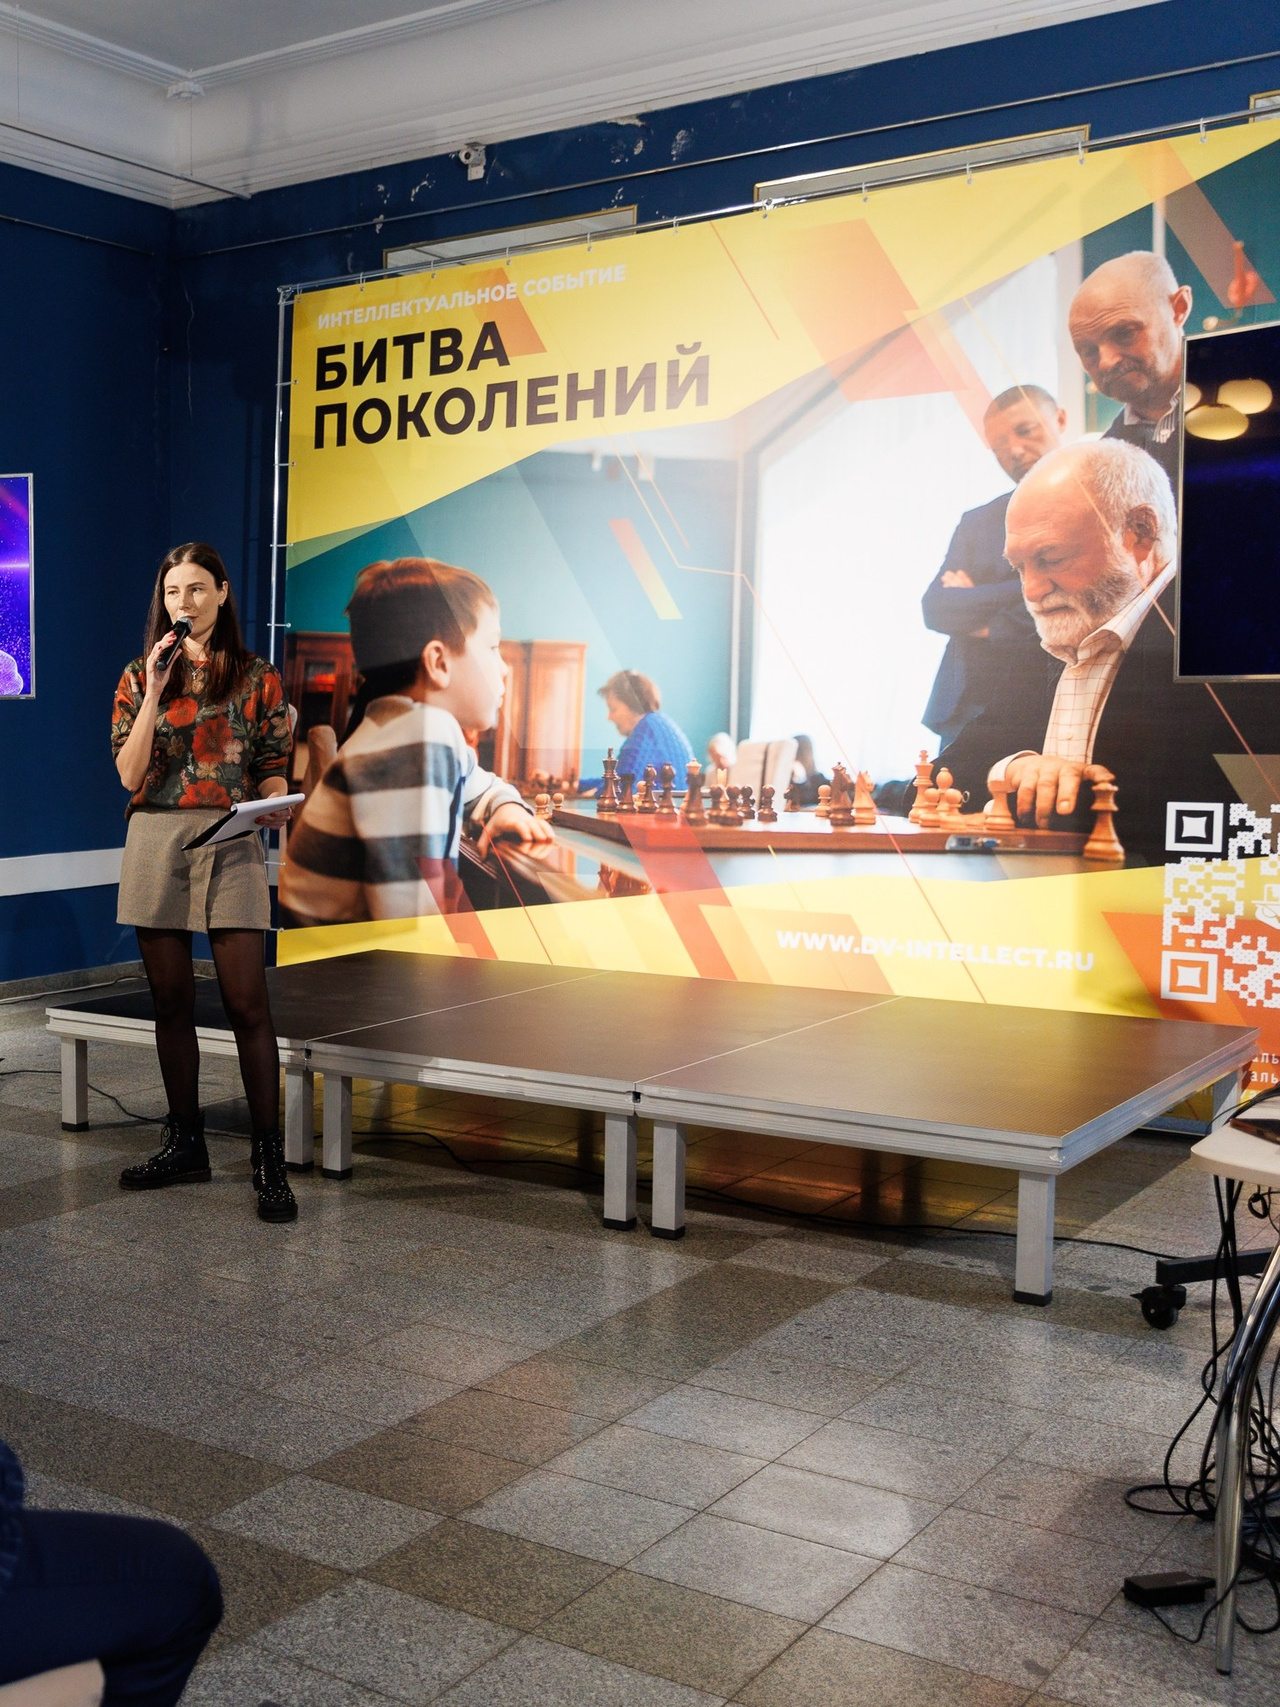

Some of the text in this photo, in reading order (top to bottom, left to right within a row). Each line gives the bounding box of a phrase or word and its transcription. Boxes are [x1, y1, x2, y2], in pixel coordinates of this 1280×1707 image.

[317, 264, 627, 330] ИНТЕЛЛЕКТУАЛЬНОЕ СОБЫТИЕ
[315, 320, 511, 392] БИТВА
[313, 341, 711, 450] ПОКОЛЕНИЙ
[775, 929, 1095, 972] WWW.DV-INTELLECT.RU
